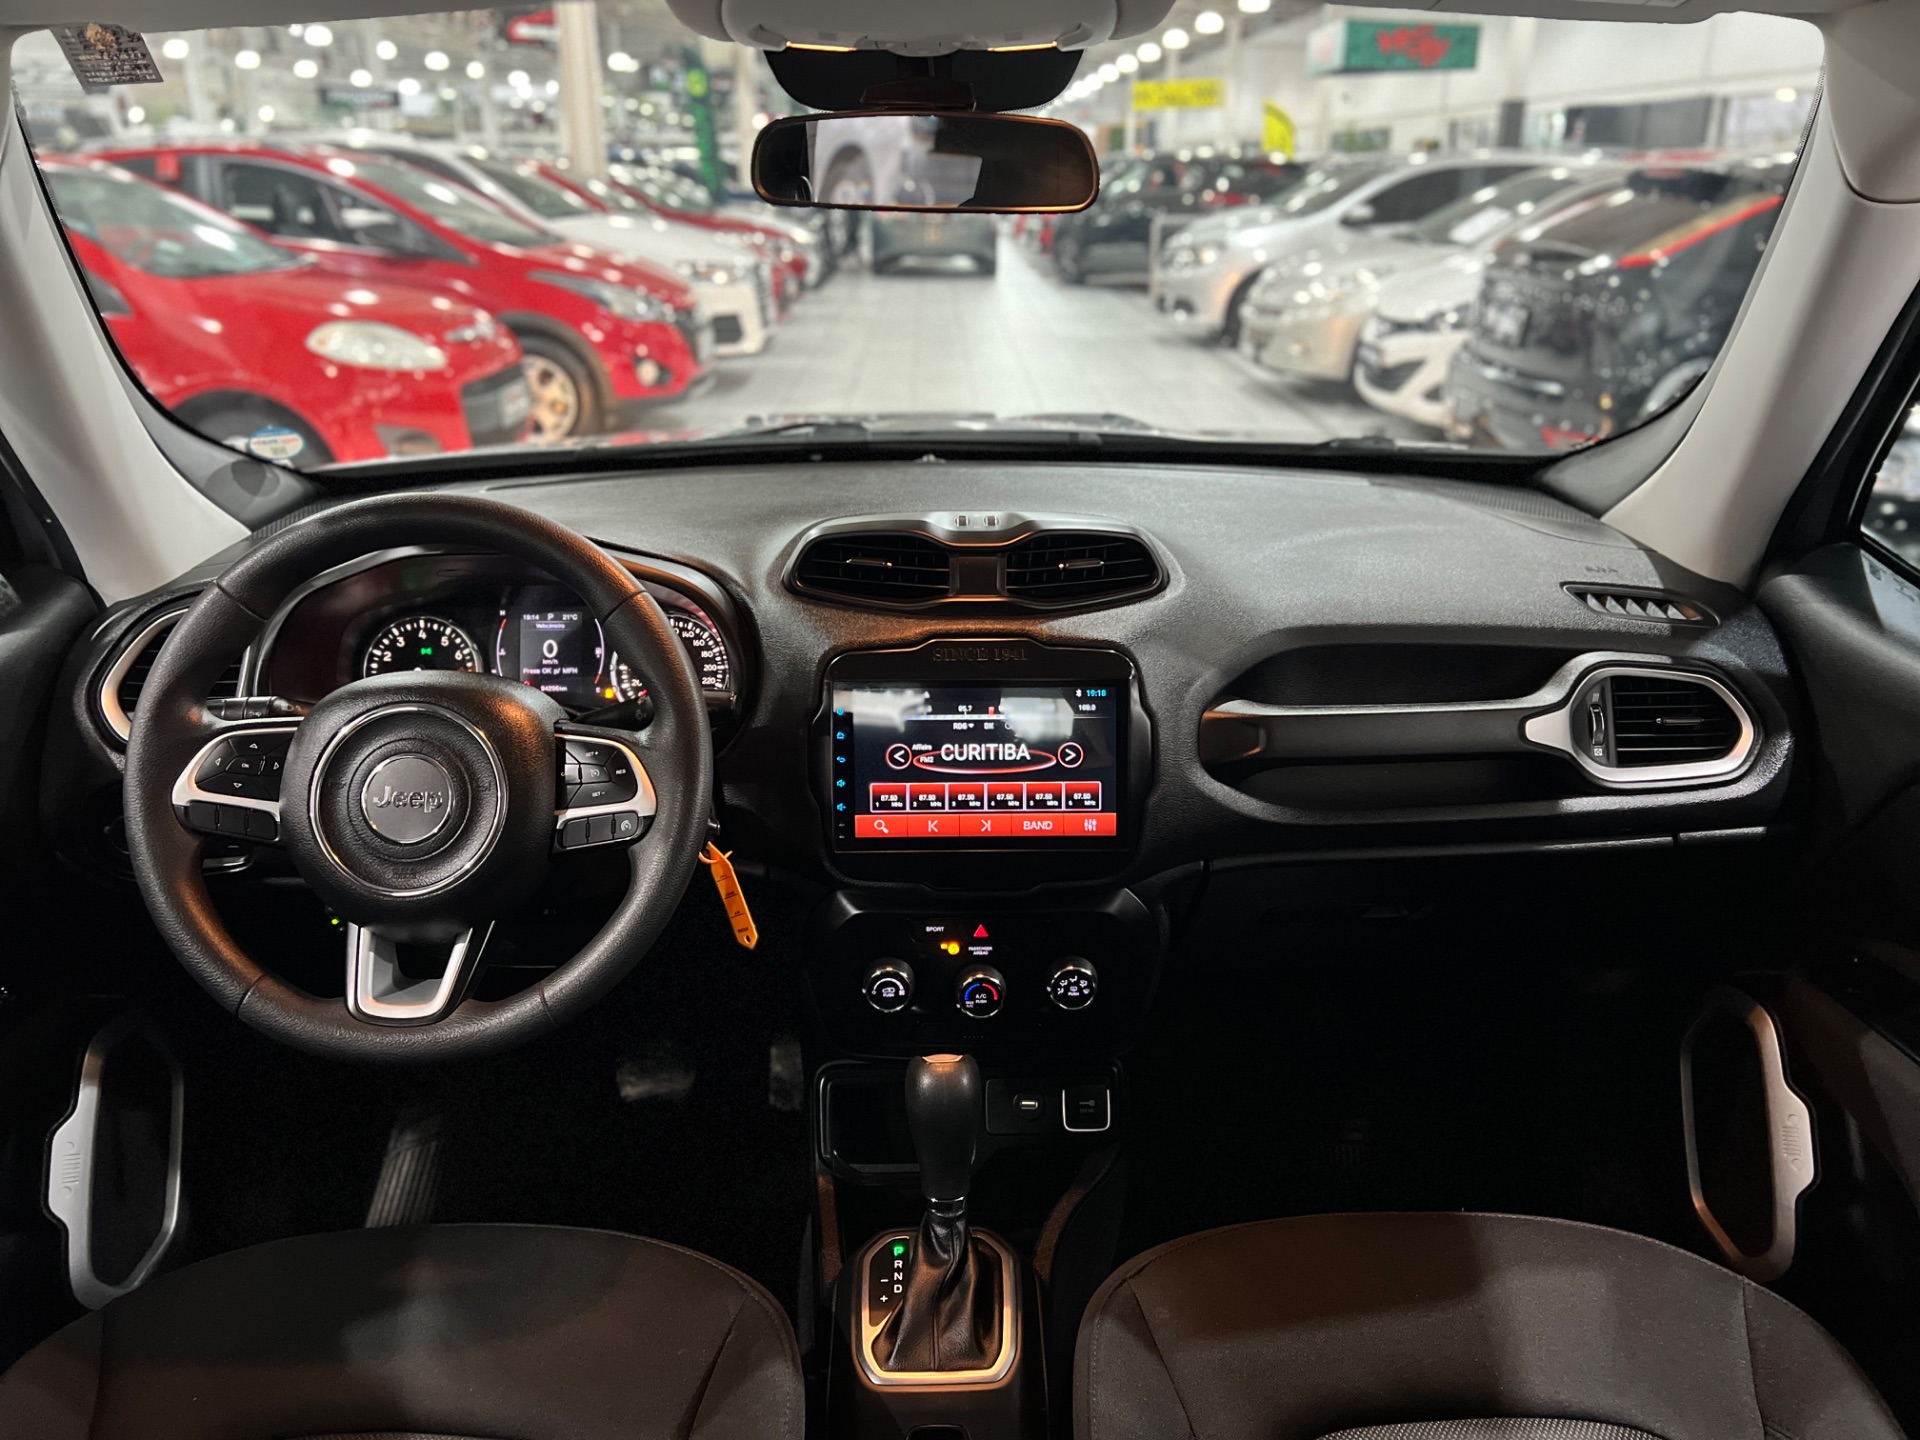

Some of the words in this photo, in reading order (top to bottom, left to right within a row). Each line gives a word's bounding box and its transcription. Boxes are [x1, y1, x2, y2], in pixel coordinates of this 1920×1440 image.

[418, 629, 427, 639] 4
[682, 630, 695, 638] 140
[396, 636, 405, 647] 3
[441, 636, 450, 647] 5
[693, 639, 706, 647] 160
[542, 639, 558, 658] 0
[383, 651, 392, 662] 2
[454, 650, 463, 660] 6
[701, 650, 713, 658] 180
[932, 647, 989, 662] SINCE
[994, 647, 1028, 661] 1941
[703, 664, 717, 672] 200
[701, 676, 716, 685] 220
[1086, 689, 1107, 697] 19:18
[953, 722, 968, 730] RDS
[940, 743, 1031, 761] CURITIBA
[372, 785, 443, 813] Jeep
[1023, 821, 1053, 830] BAND
[893, 1246, 904, 1256] P
[894, 1260, 903, 1268] R
[894, 1272, 903, 1281] N
[894, 1284, 903, 1293] D
